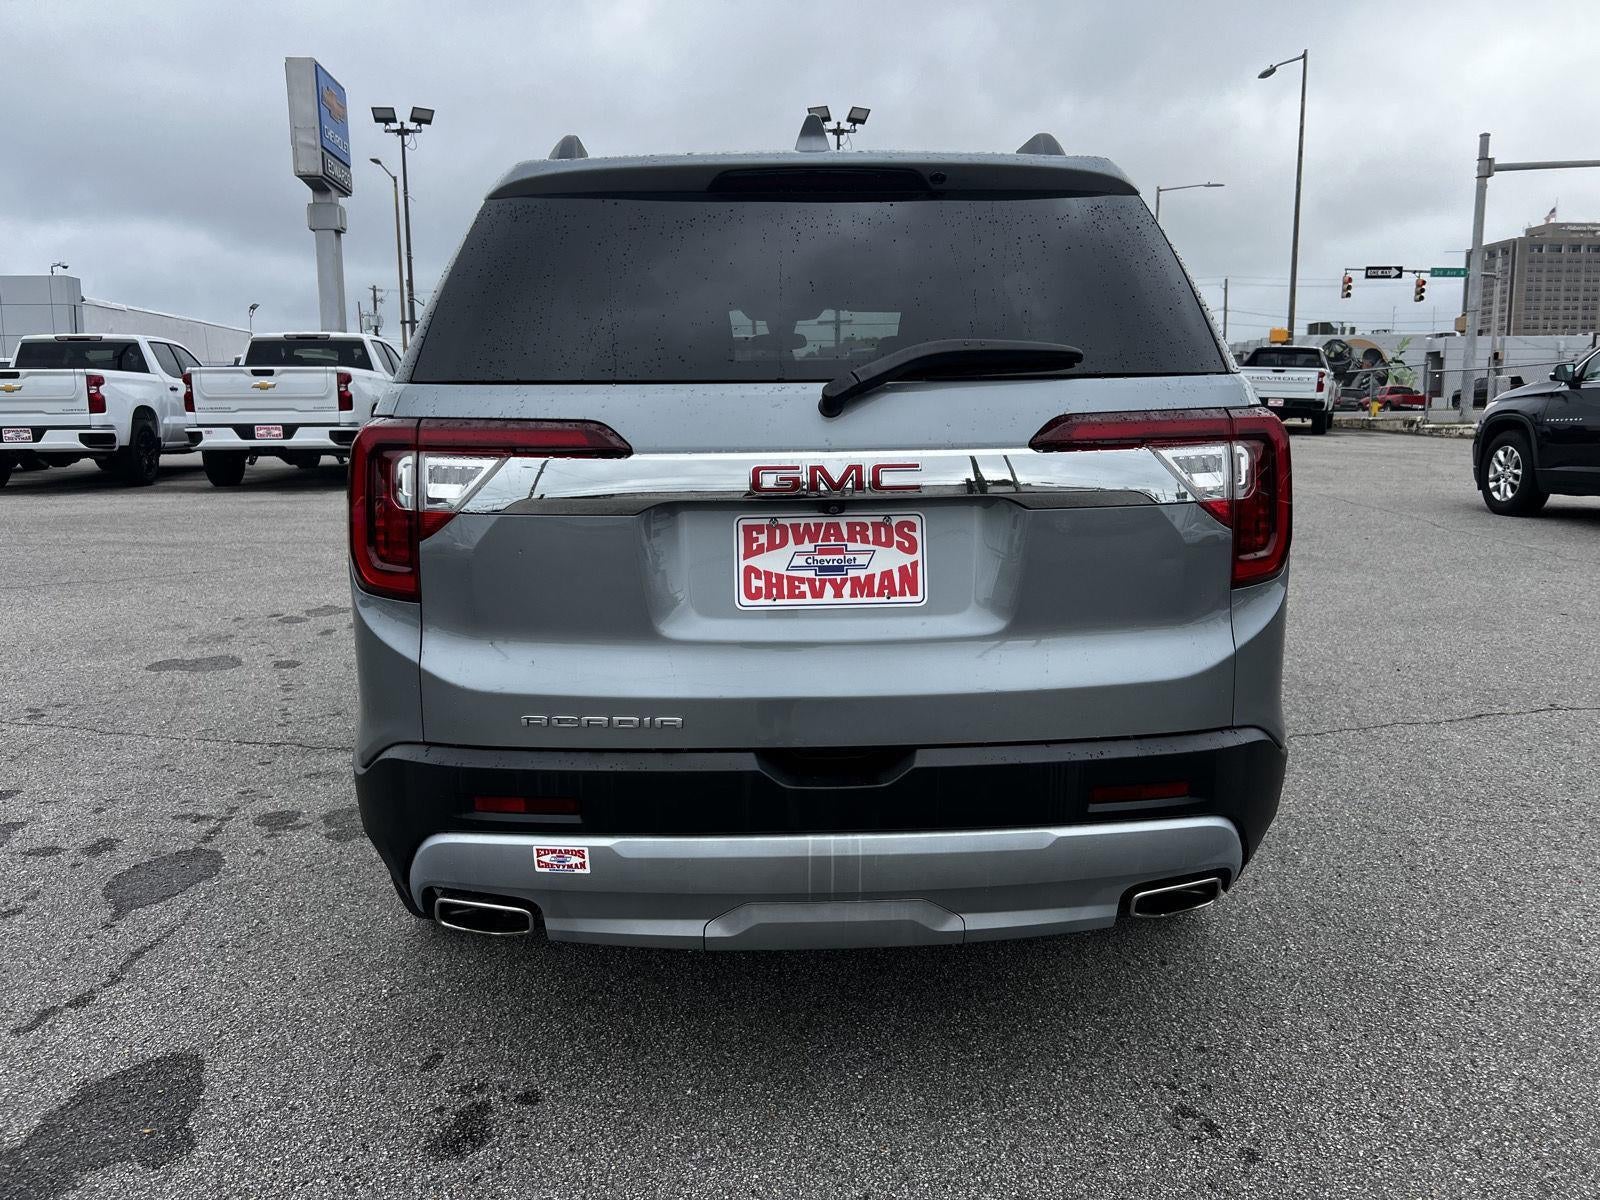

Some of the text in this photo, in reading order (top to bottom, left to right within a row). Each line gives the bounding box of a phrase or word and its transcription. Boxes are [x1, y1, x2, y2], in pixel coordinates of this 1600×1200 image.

[327, 159, 351, 187] EDWARDS
[749, 462, 922, 495] GMC
[742, 520, 918, 560] EDWARDS
[804, 554, 857, 566] Chevrolet
[743, 560, 919, 602] CHEVYMAN
[520, 715, 684, 729] ACADIA
[536, 848, 586, 859] EDWARDS
[536, 859, 587, 870] CHEVYMAN
